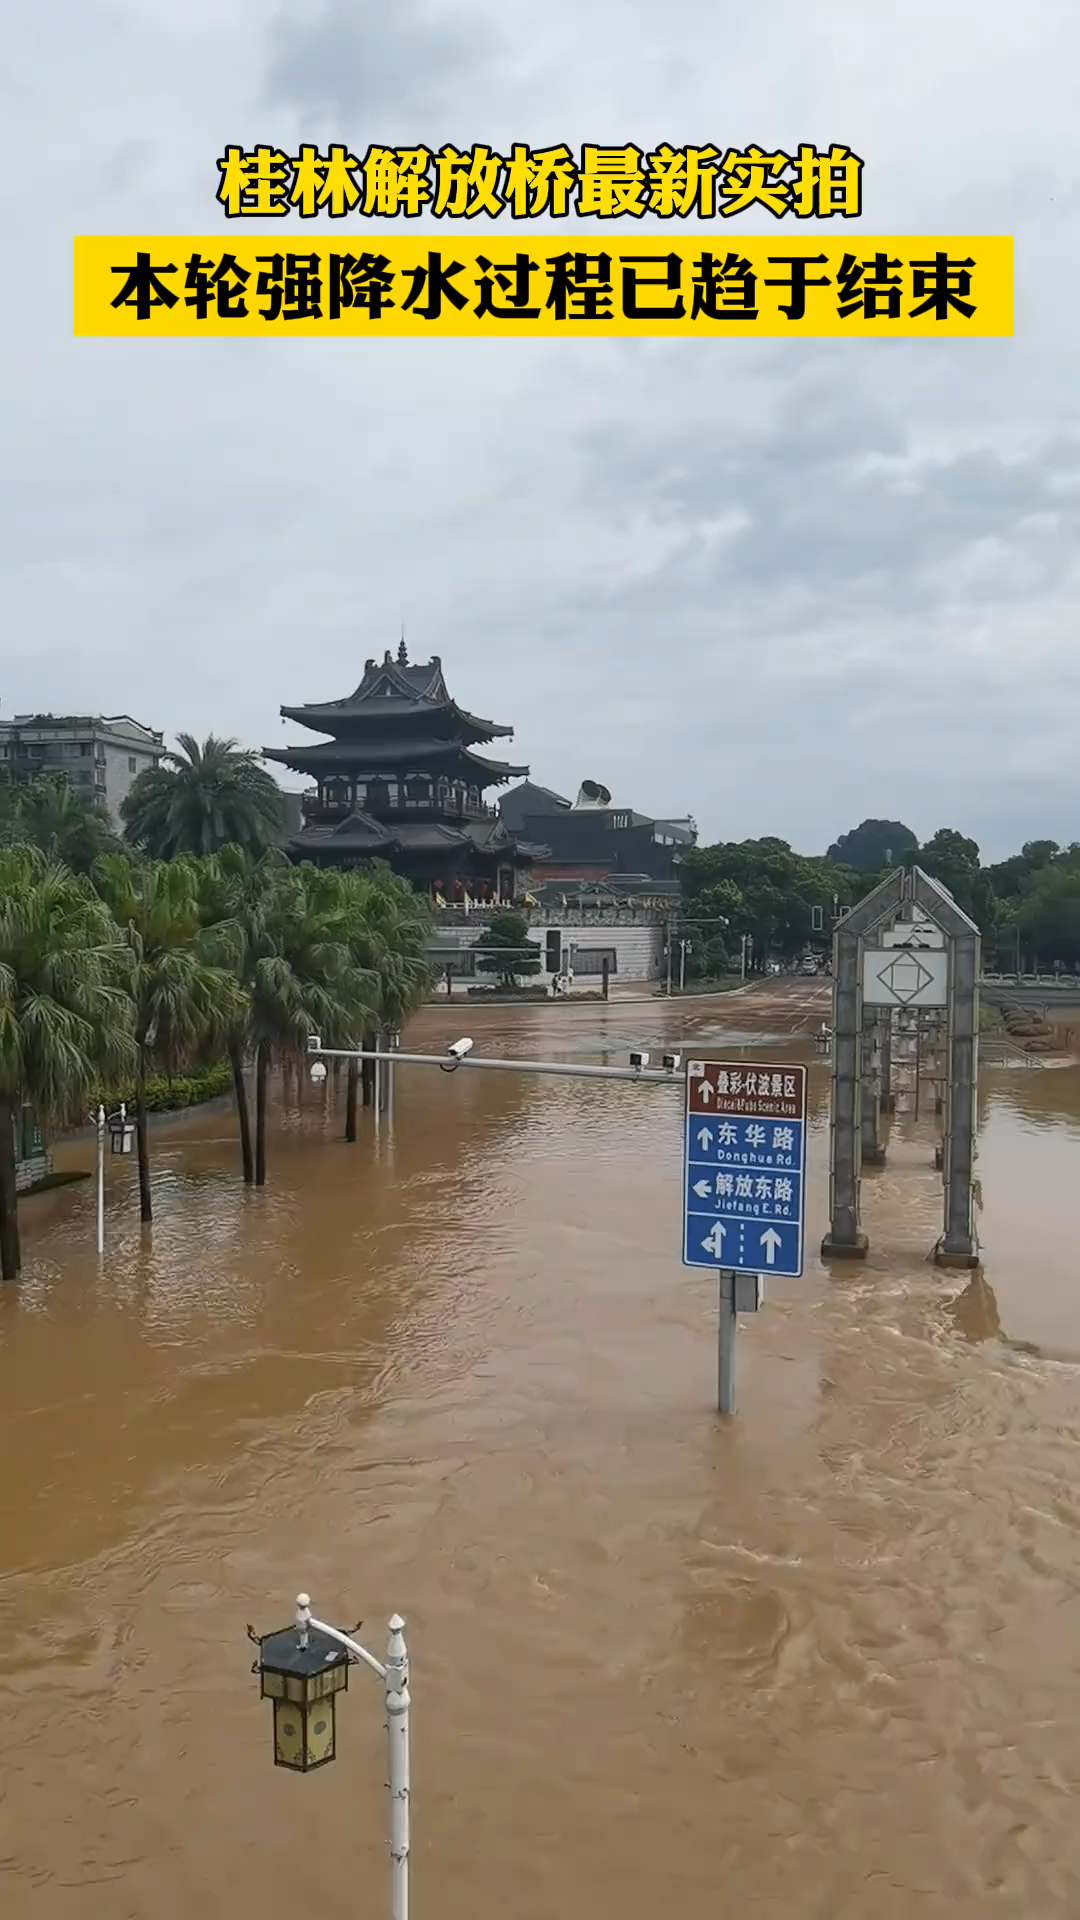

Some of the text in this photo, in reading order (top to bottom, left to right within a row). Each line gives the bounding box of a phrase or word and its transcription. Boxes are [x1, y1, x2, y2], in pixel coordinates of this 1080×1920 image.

[717, 1121, 795, 1151] 东华路
[717, 1149, 796, 1166] Donghua Rd.
[715, 1171, 793, 1202] 解放东路
[714, 1199, 759, 1215] Jiefang
[775, 1204, 792, 1216] Rd.
